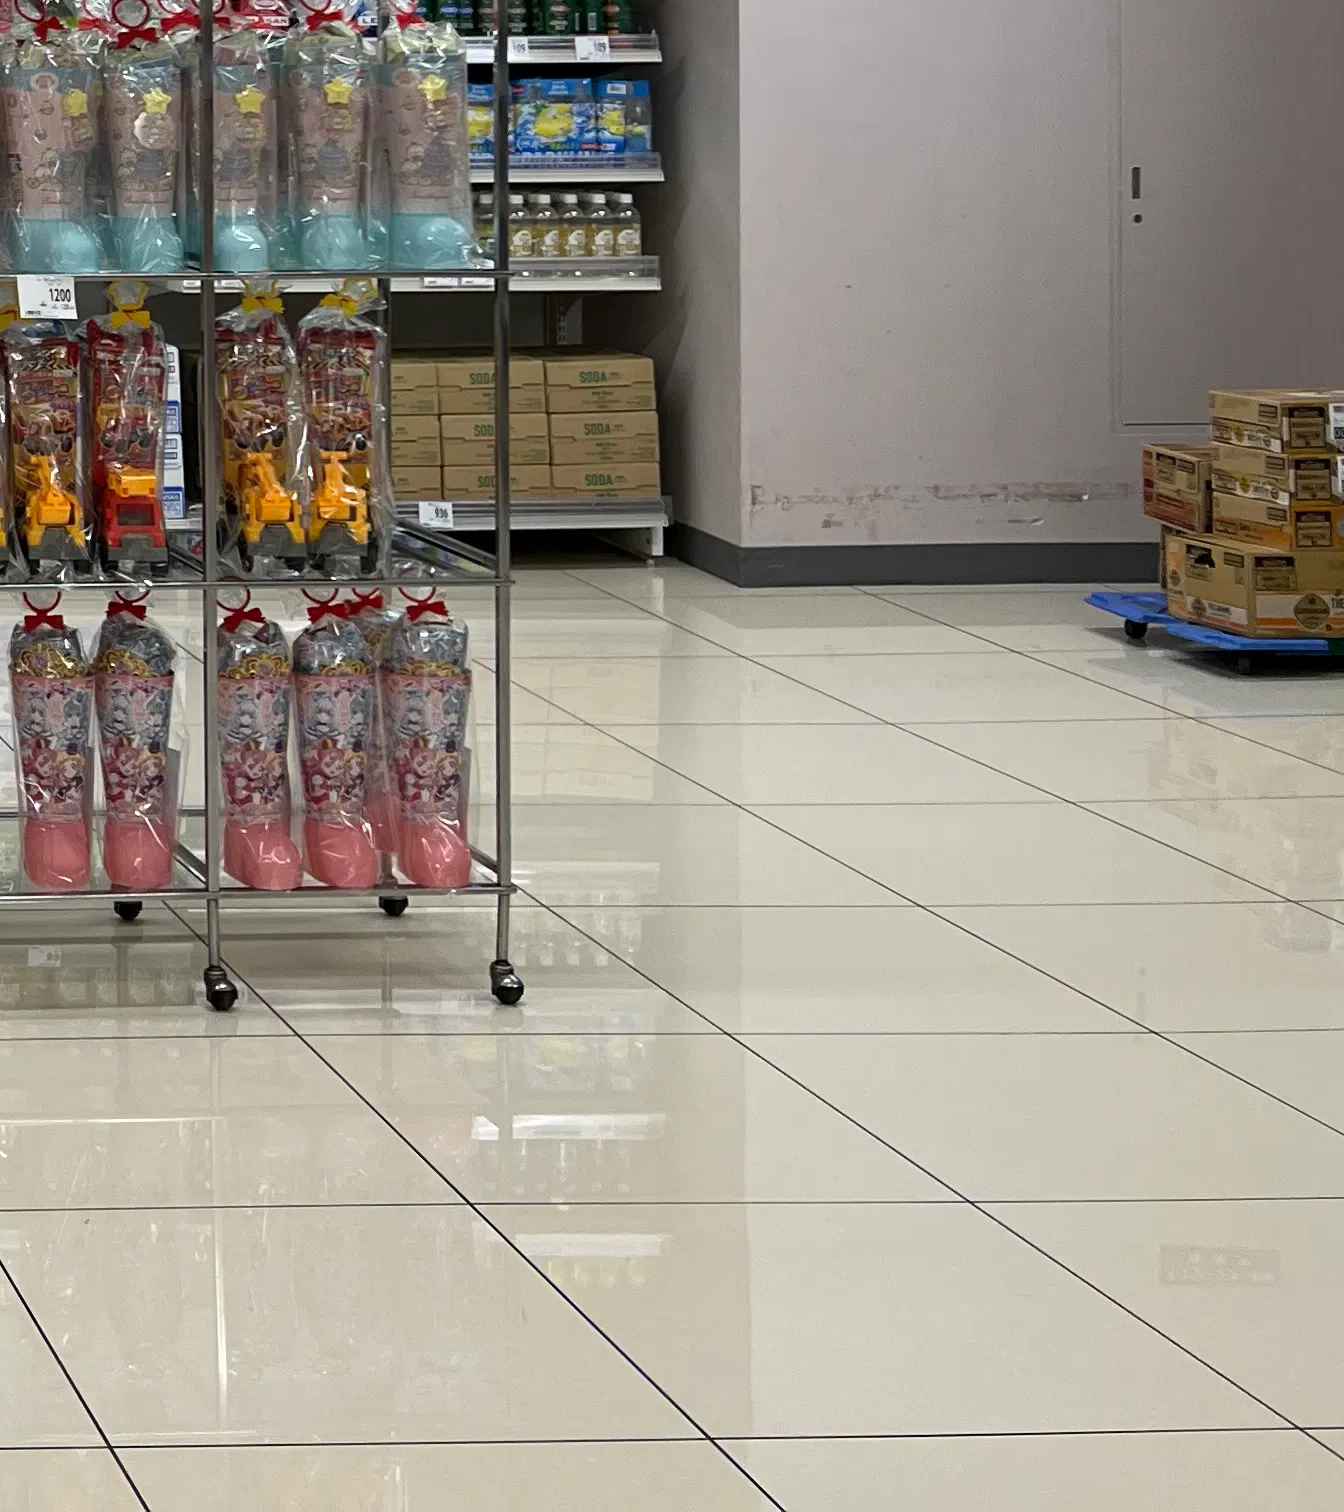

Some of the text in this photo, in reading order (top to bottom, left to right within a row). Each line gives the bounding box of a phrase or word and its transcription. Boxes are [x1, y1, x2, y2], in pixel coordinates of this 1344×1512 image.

[49, 287, 72, 303] 1200
[579, 371, 608, 383] SODA
[473, 424, 496, 436] SOD
[584, 423, 612, 436] SODA
[584, 474, 613, 486] SODA
